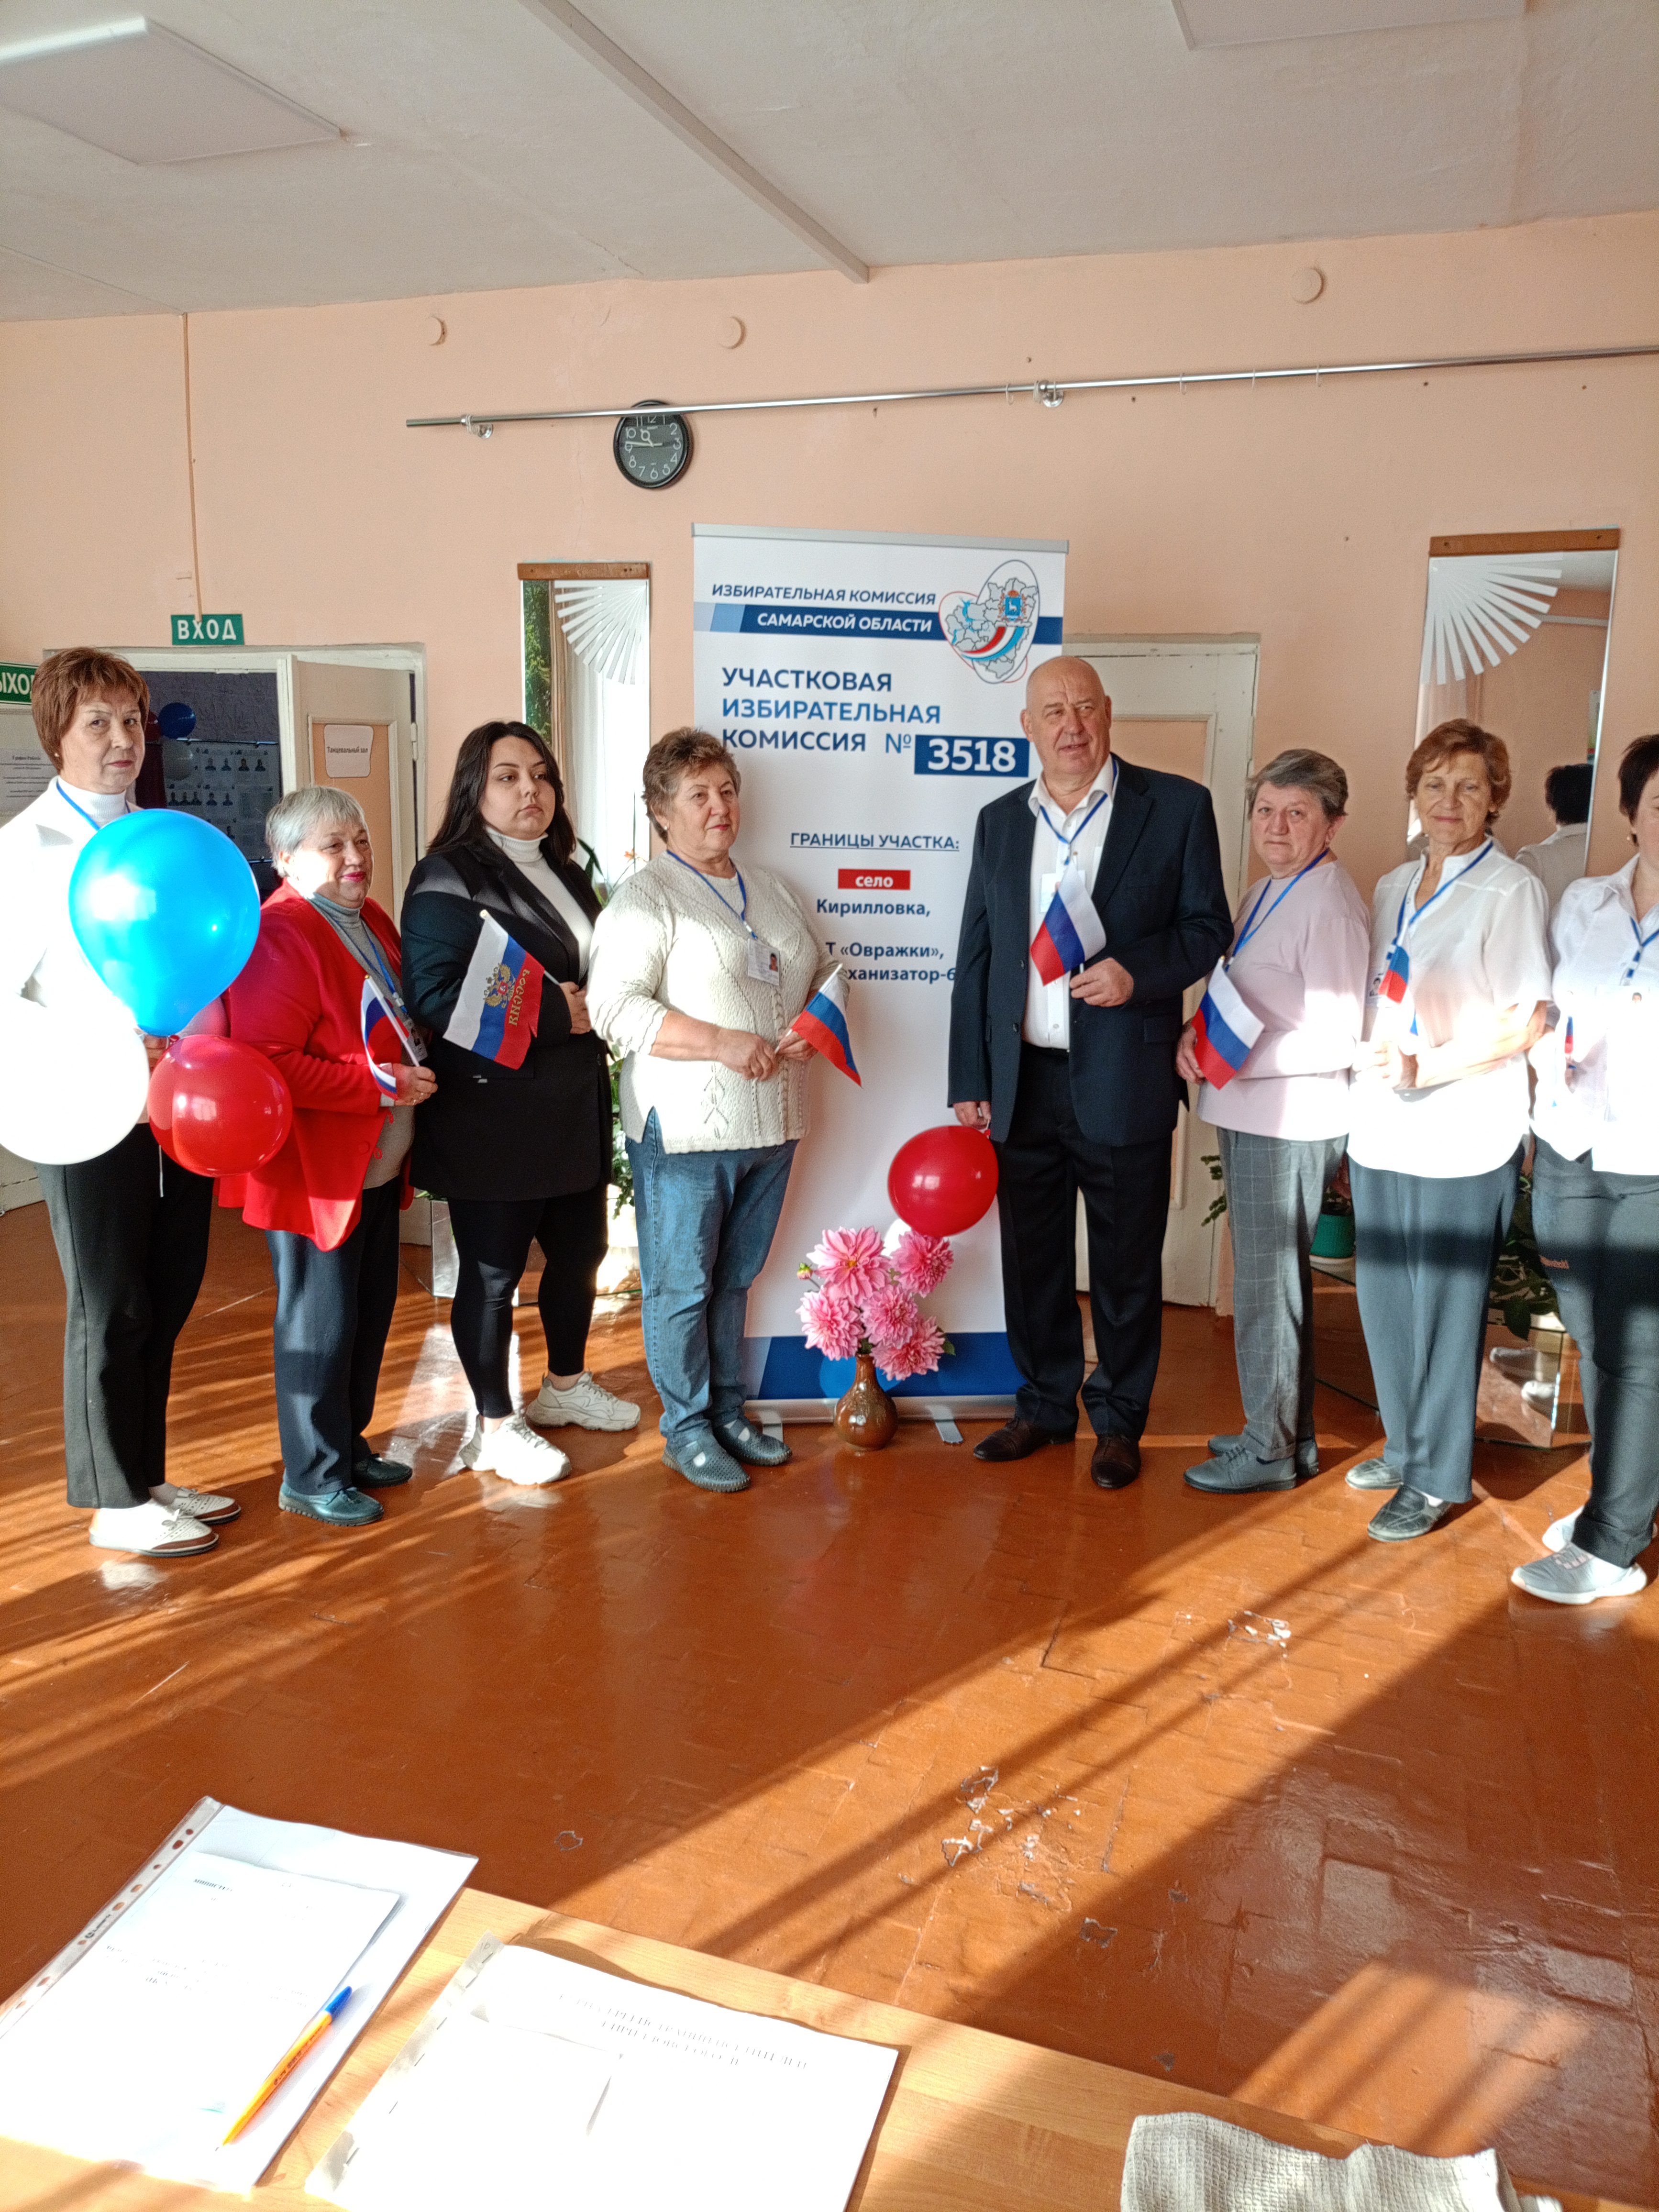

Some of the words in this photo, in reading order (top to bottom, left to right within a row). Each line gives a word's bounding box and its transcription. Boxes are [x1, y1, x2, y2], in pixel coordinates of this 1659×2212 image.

[626, 427, 636, 439] 10
[669, 422, 677, 435] 2
[673, 437, 681, 450] 3
[629, 455, 637, 468] 8
[670, 453, 678, 465] 4
[639, 466, 646, 477] 7
[650, 468, 658, 480] 6
[662, 464, 670, 476] 5
[711, 584, 845, 601] ИЗБИРАТЕЛЬНАЯ
[849, 590, 936, 605] КОМИССИЯ
[757, 612, 856, 629] САМАРСКОЙ
[859, 617, 932, 632] ОБЛАСТИ
[177, 619, 236, 641] ВХОД
[722, 667, 892, 692] УЧАСТКОВАЯ
[722, 698, 940, 724] ИЗБИРАТЕЛЬНАЯ
[326, 746, 360, 754] Танцевальный
[722, 729, 866, 752] КОМИССИЯ
[885, 733, 912, 754] №
[928, 740, 1016, 773] 3518
[790, 832, 874, 848] ГРАНИЦЫ
[879, 835, 960, 849] УЧАСТКА:
[855, 875, 894, 888] село
[817, 898, 930, 917] Кирилловка,
[826, 942, 836, 956] Т
[840, 942, 944, 960] «Овражки»,
[848, 967, 956, 984] ханизатор-6
